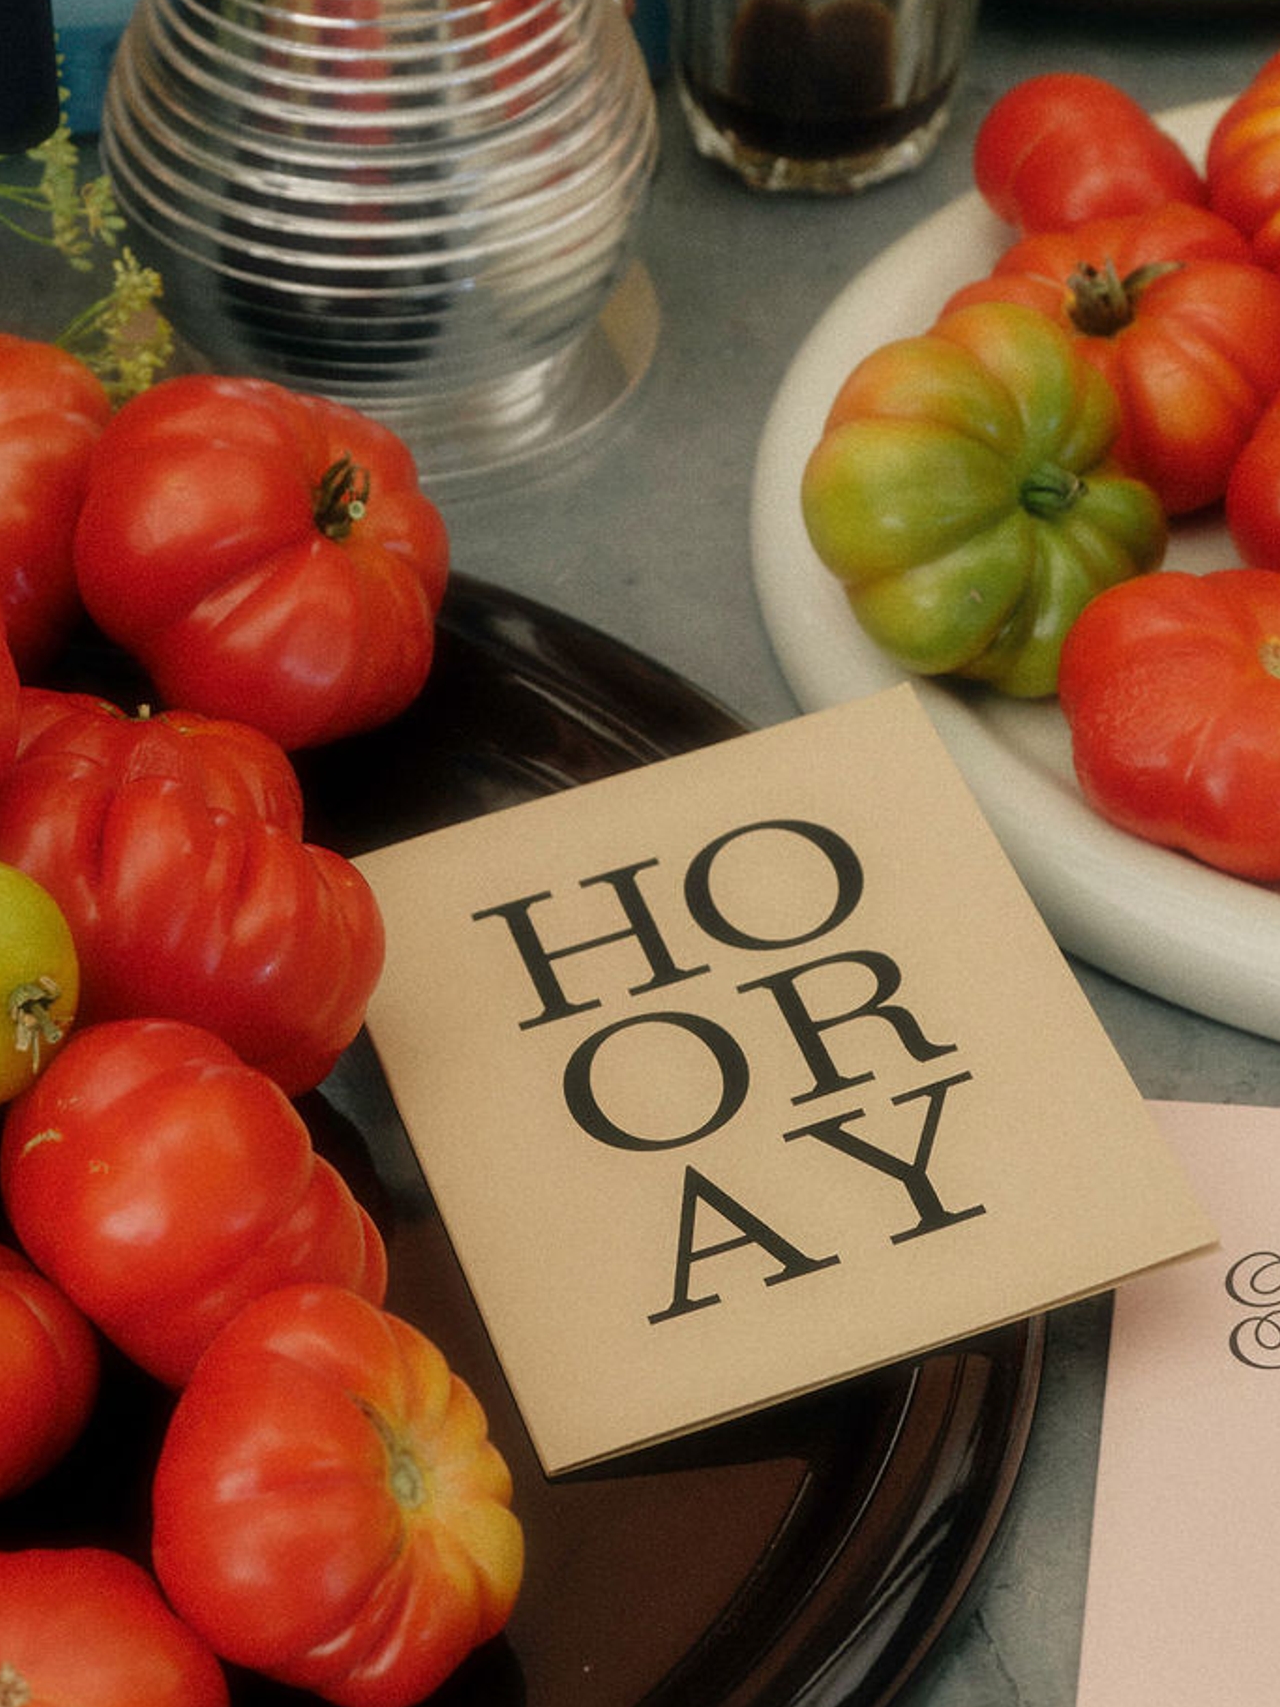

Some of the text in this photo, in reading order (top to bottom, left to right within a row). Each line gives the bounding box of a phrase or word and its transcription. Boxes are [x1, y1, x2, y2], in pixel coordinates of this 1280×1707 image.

[470, 818, 865, 1032] HO
[562, 949, 959, 1153] OR
[646, 1069, 988, 1326] AY
